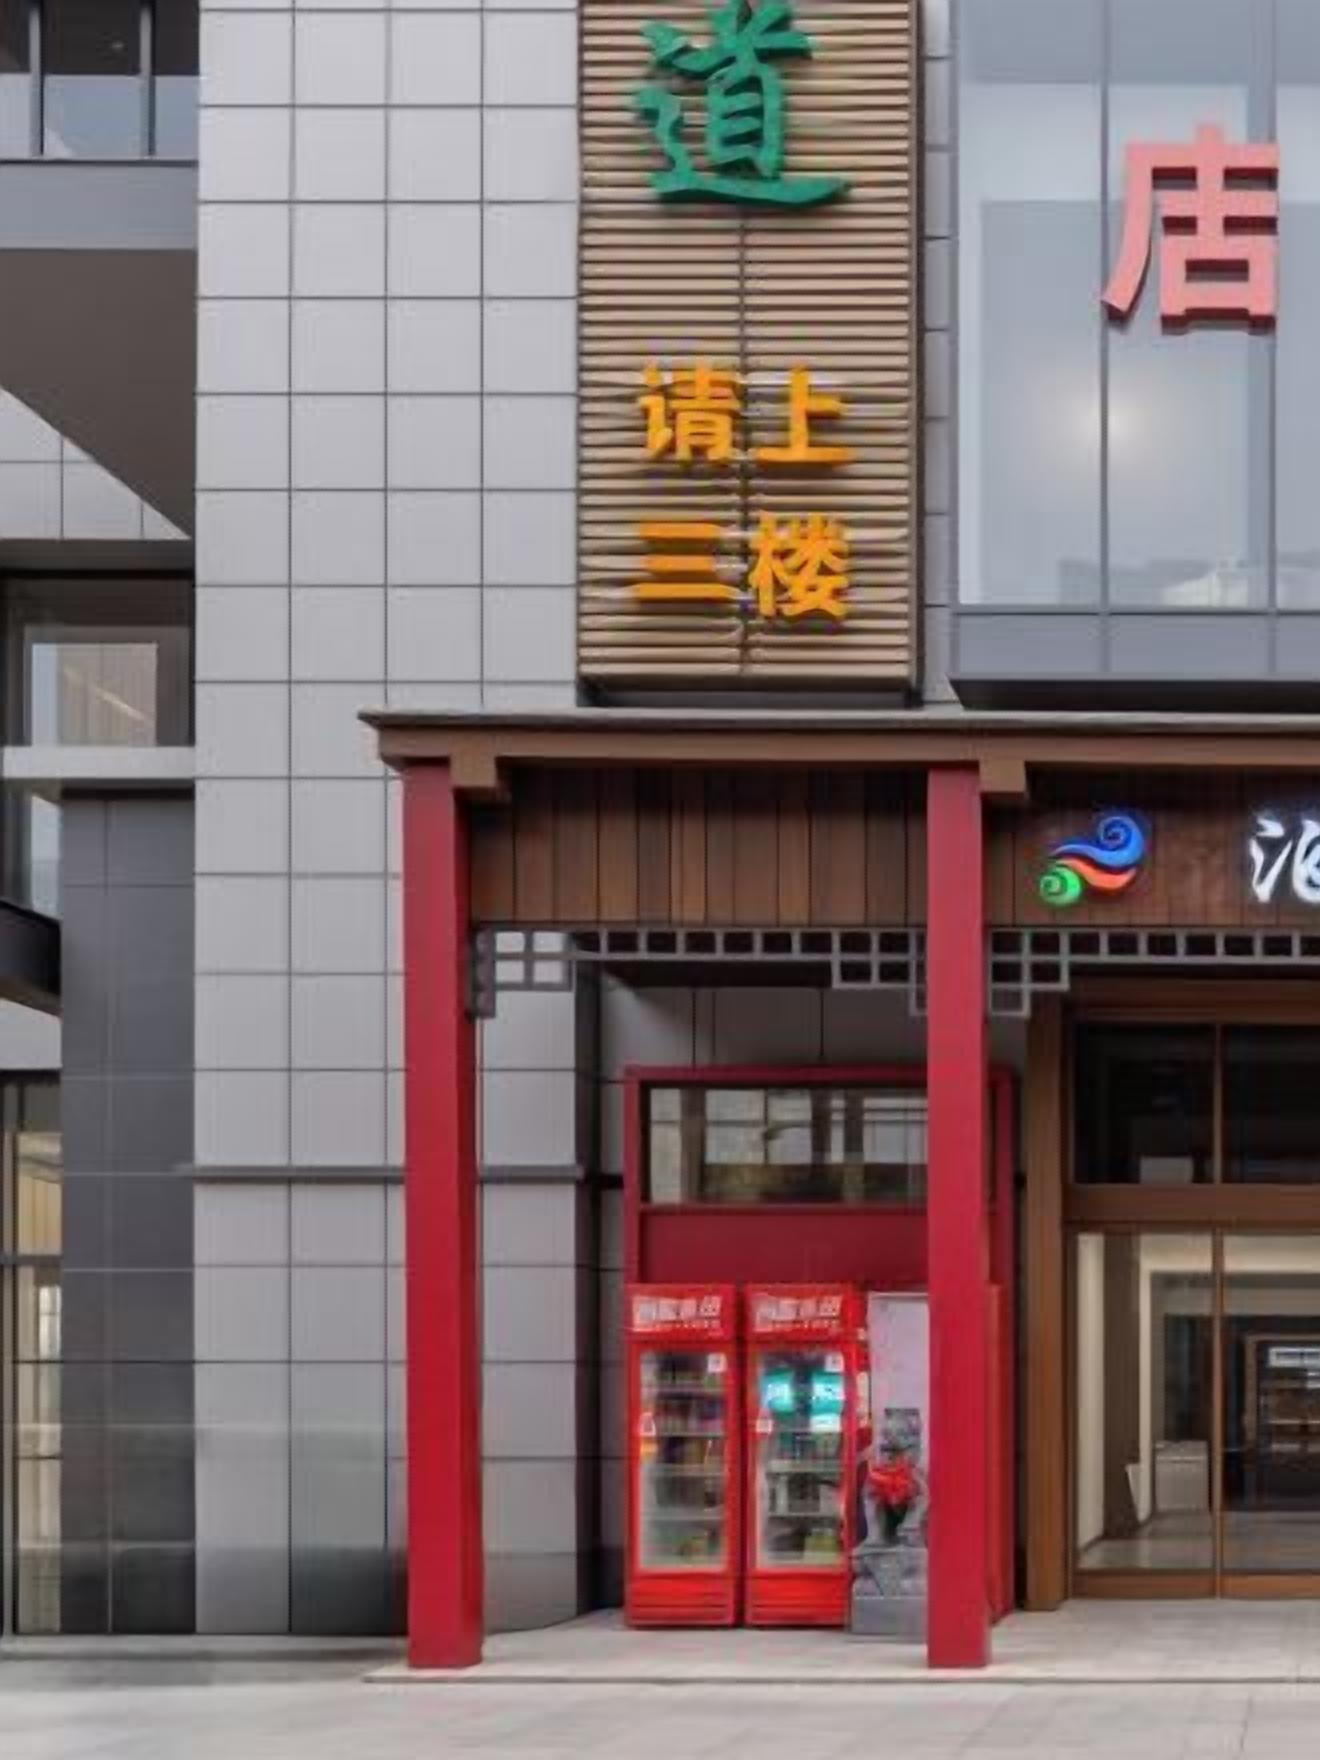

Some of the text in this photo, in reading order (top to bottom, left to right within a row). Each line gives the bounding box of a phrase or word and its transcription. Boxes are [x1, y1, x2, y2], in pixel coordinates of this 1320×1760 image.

[634, 0, 850, 208] 道
[1101, 120, 1280, 334] 店
[636, 360, 856, 472] 请上
[632, 512, 852, 624] 三楼
